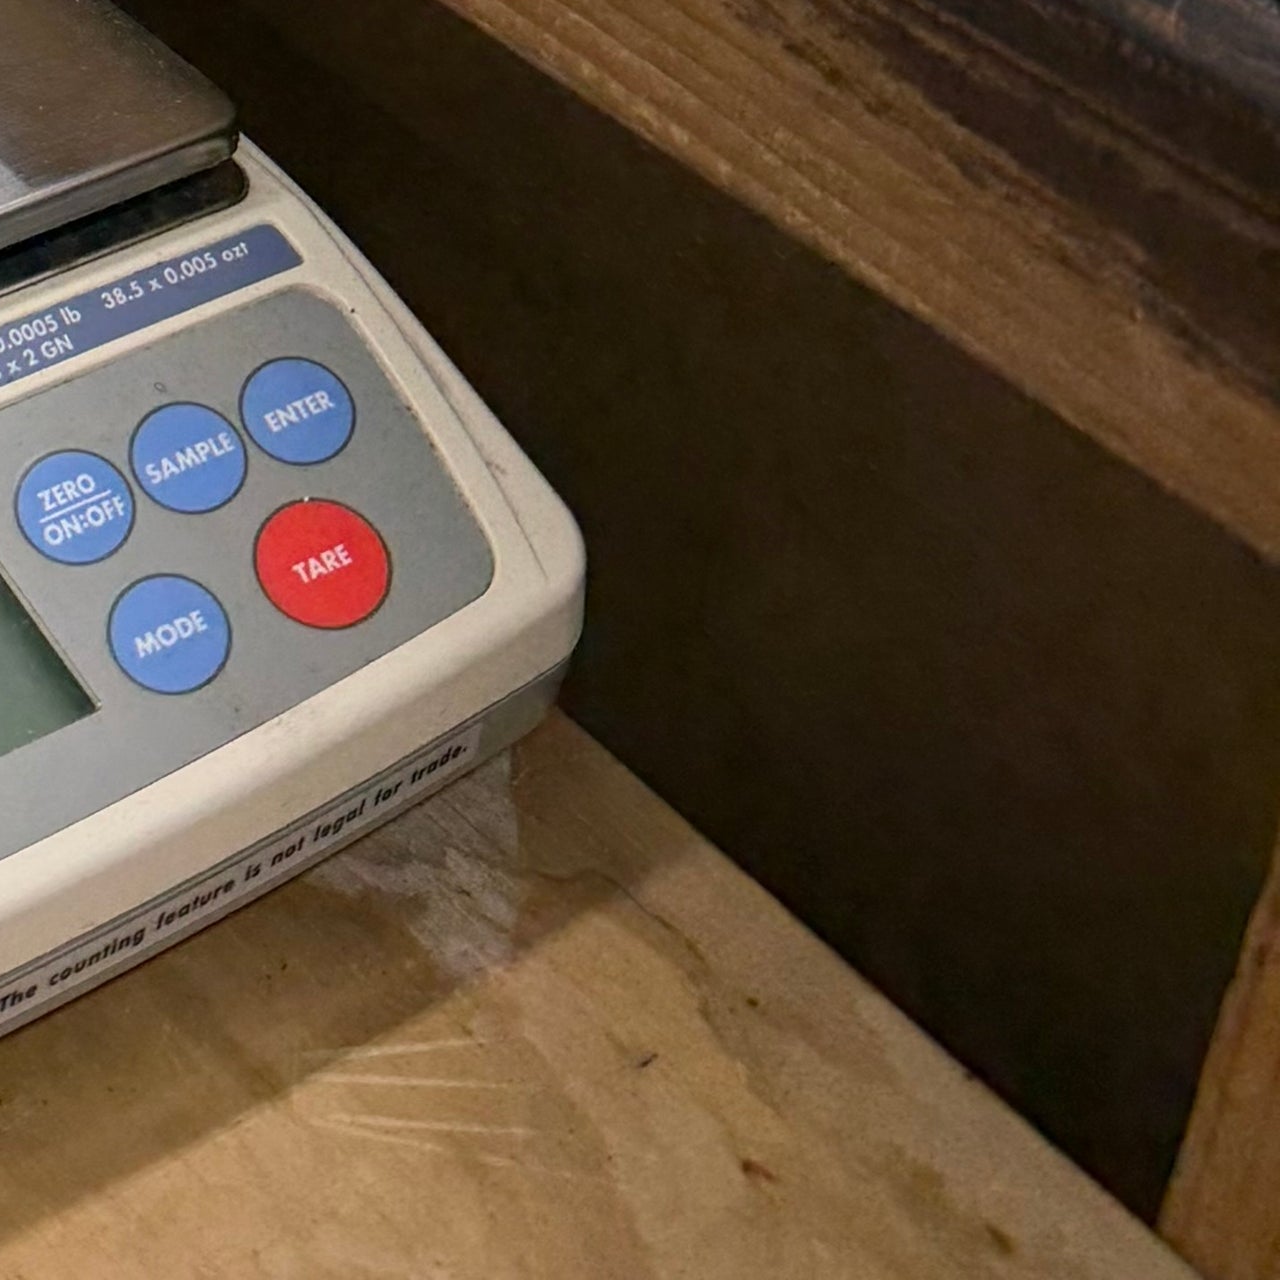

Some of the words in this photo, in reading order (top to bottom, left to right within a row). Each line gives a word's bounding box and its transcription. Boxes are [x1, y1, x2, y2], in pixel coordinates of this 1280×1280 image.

[59, 306, 82, 325] lb
[100, 280, 145, 309] 38.5
[163, 252, 218, 285] 0.005
[221, 242, 250, 262] ozt
[22, 349, 39, 368] 2
[40, 334, 74, 360] GN
[263, 390, 335, 433] ENTER
[145, 431, 236, 485] SAMPLE
[37, 472, 96, 512] ZERO
[292, 543, 353, 584] TARE
[134, 609, 209, 659] MODE
[48, 928, 146, 987] counting
[156, 877, 235, 930] feature
[244, 862, 262, 882] is
[270, 836, 305, 868] not
[313, 799, 366, 843] legal
[374, 779, 404, 807] for
[410, 743, 468, 784] trade.
